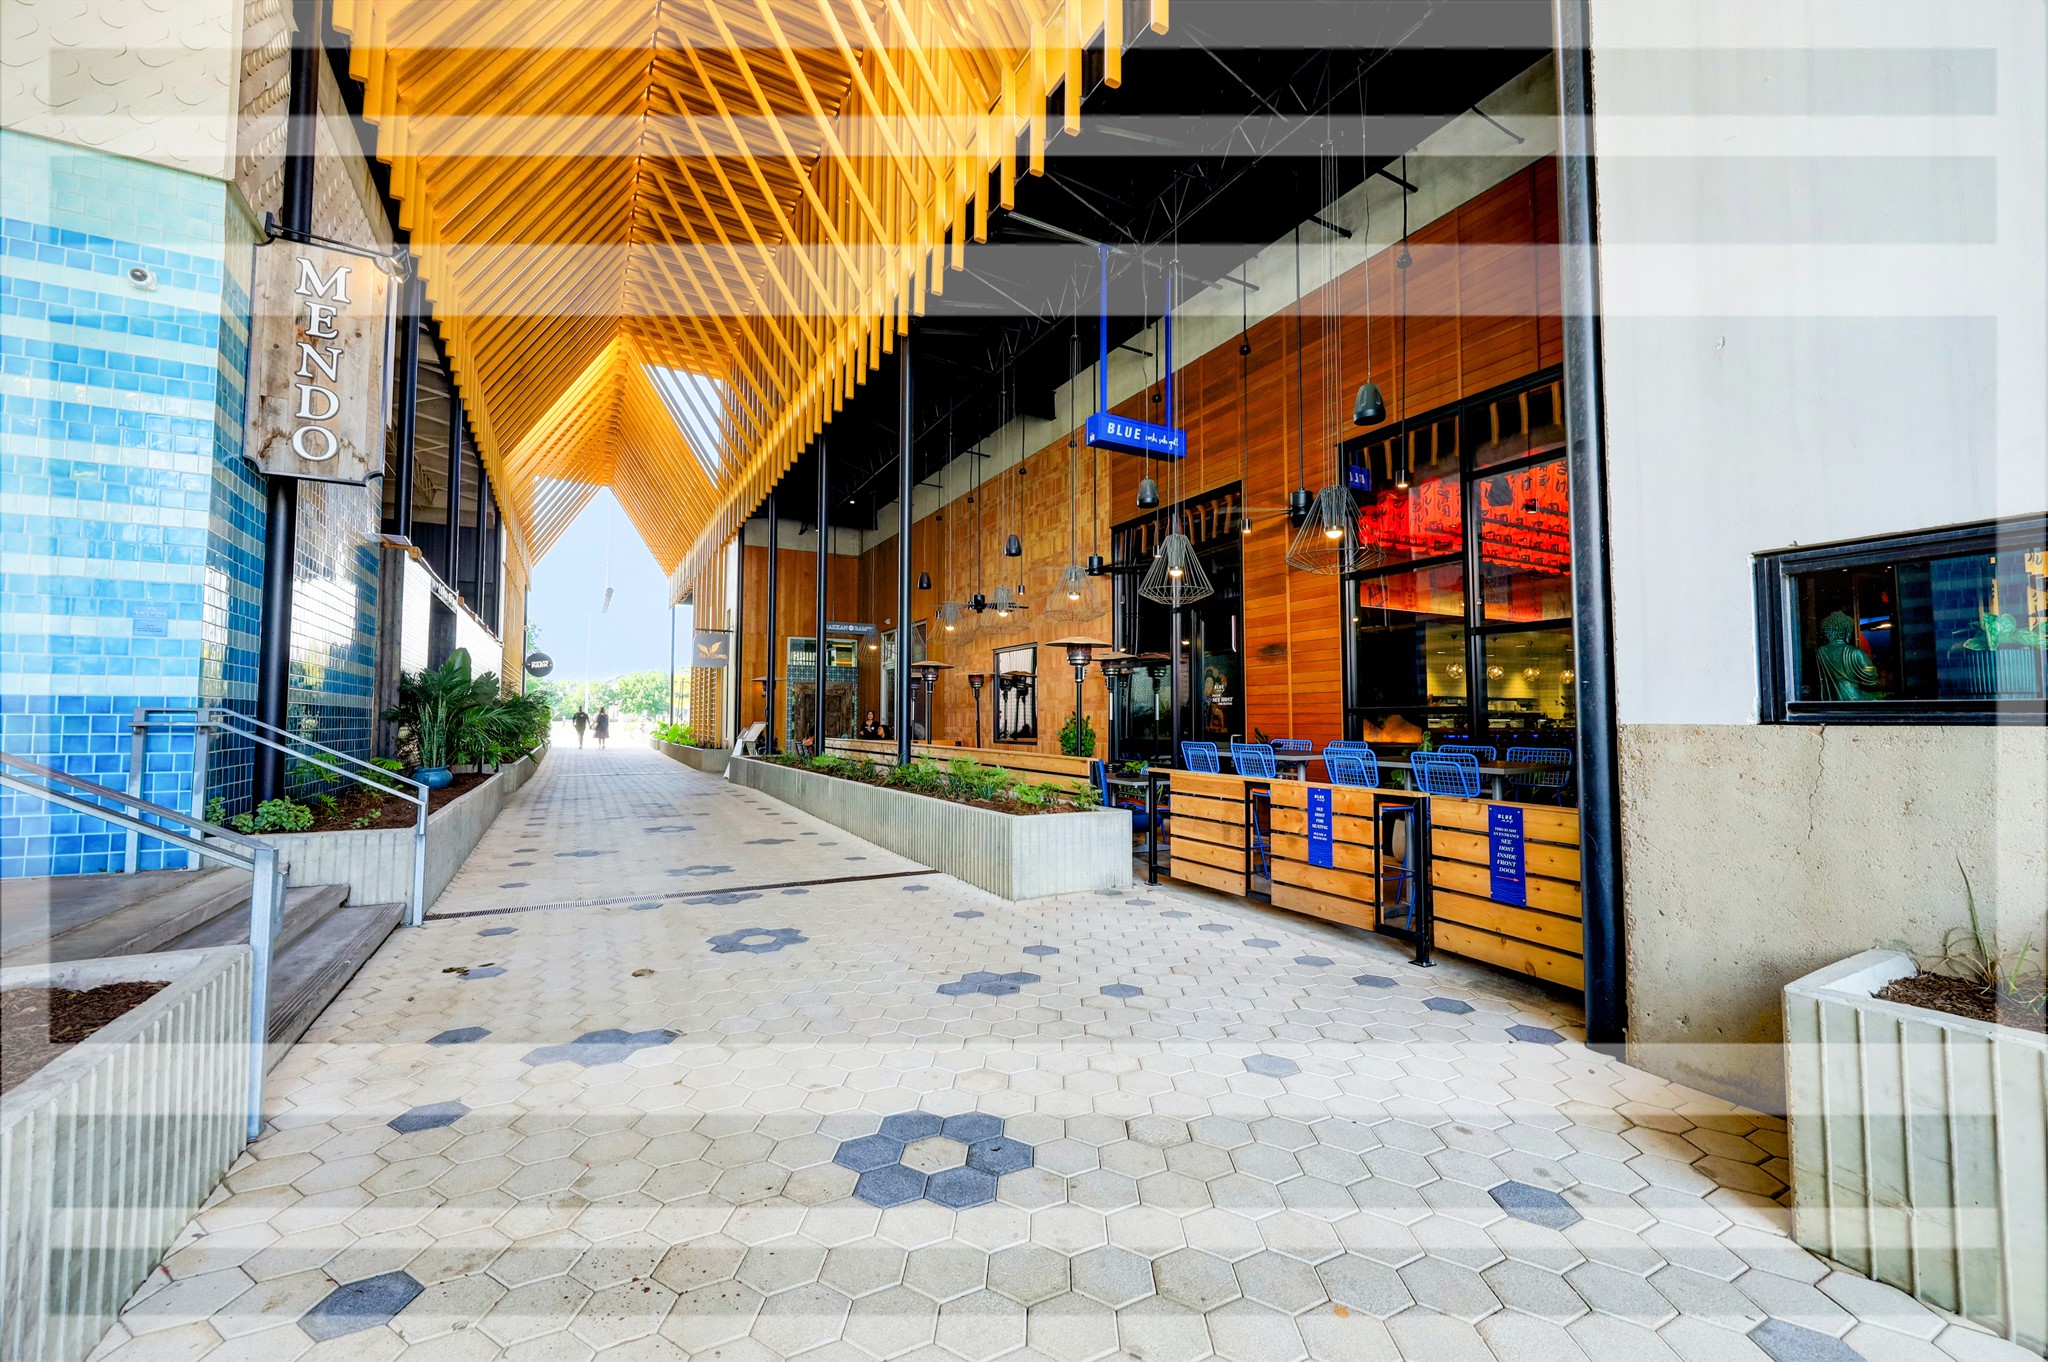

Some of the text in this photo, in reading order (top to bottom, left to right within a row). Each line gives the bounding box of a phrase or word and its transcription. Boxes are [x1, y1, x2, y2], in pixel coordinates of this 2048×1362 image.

[294, 256, 352, 462] MENDO
[1107, 422, 1141, 440] BLUE
[1497, 852, 1517, 860] INSIDE
